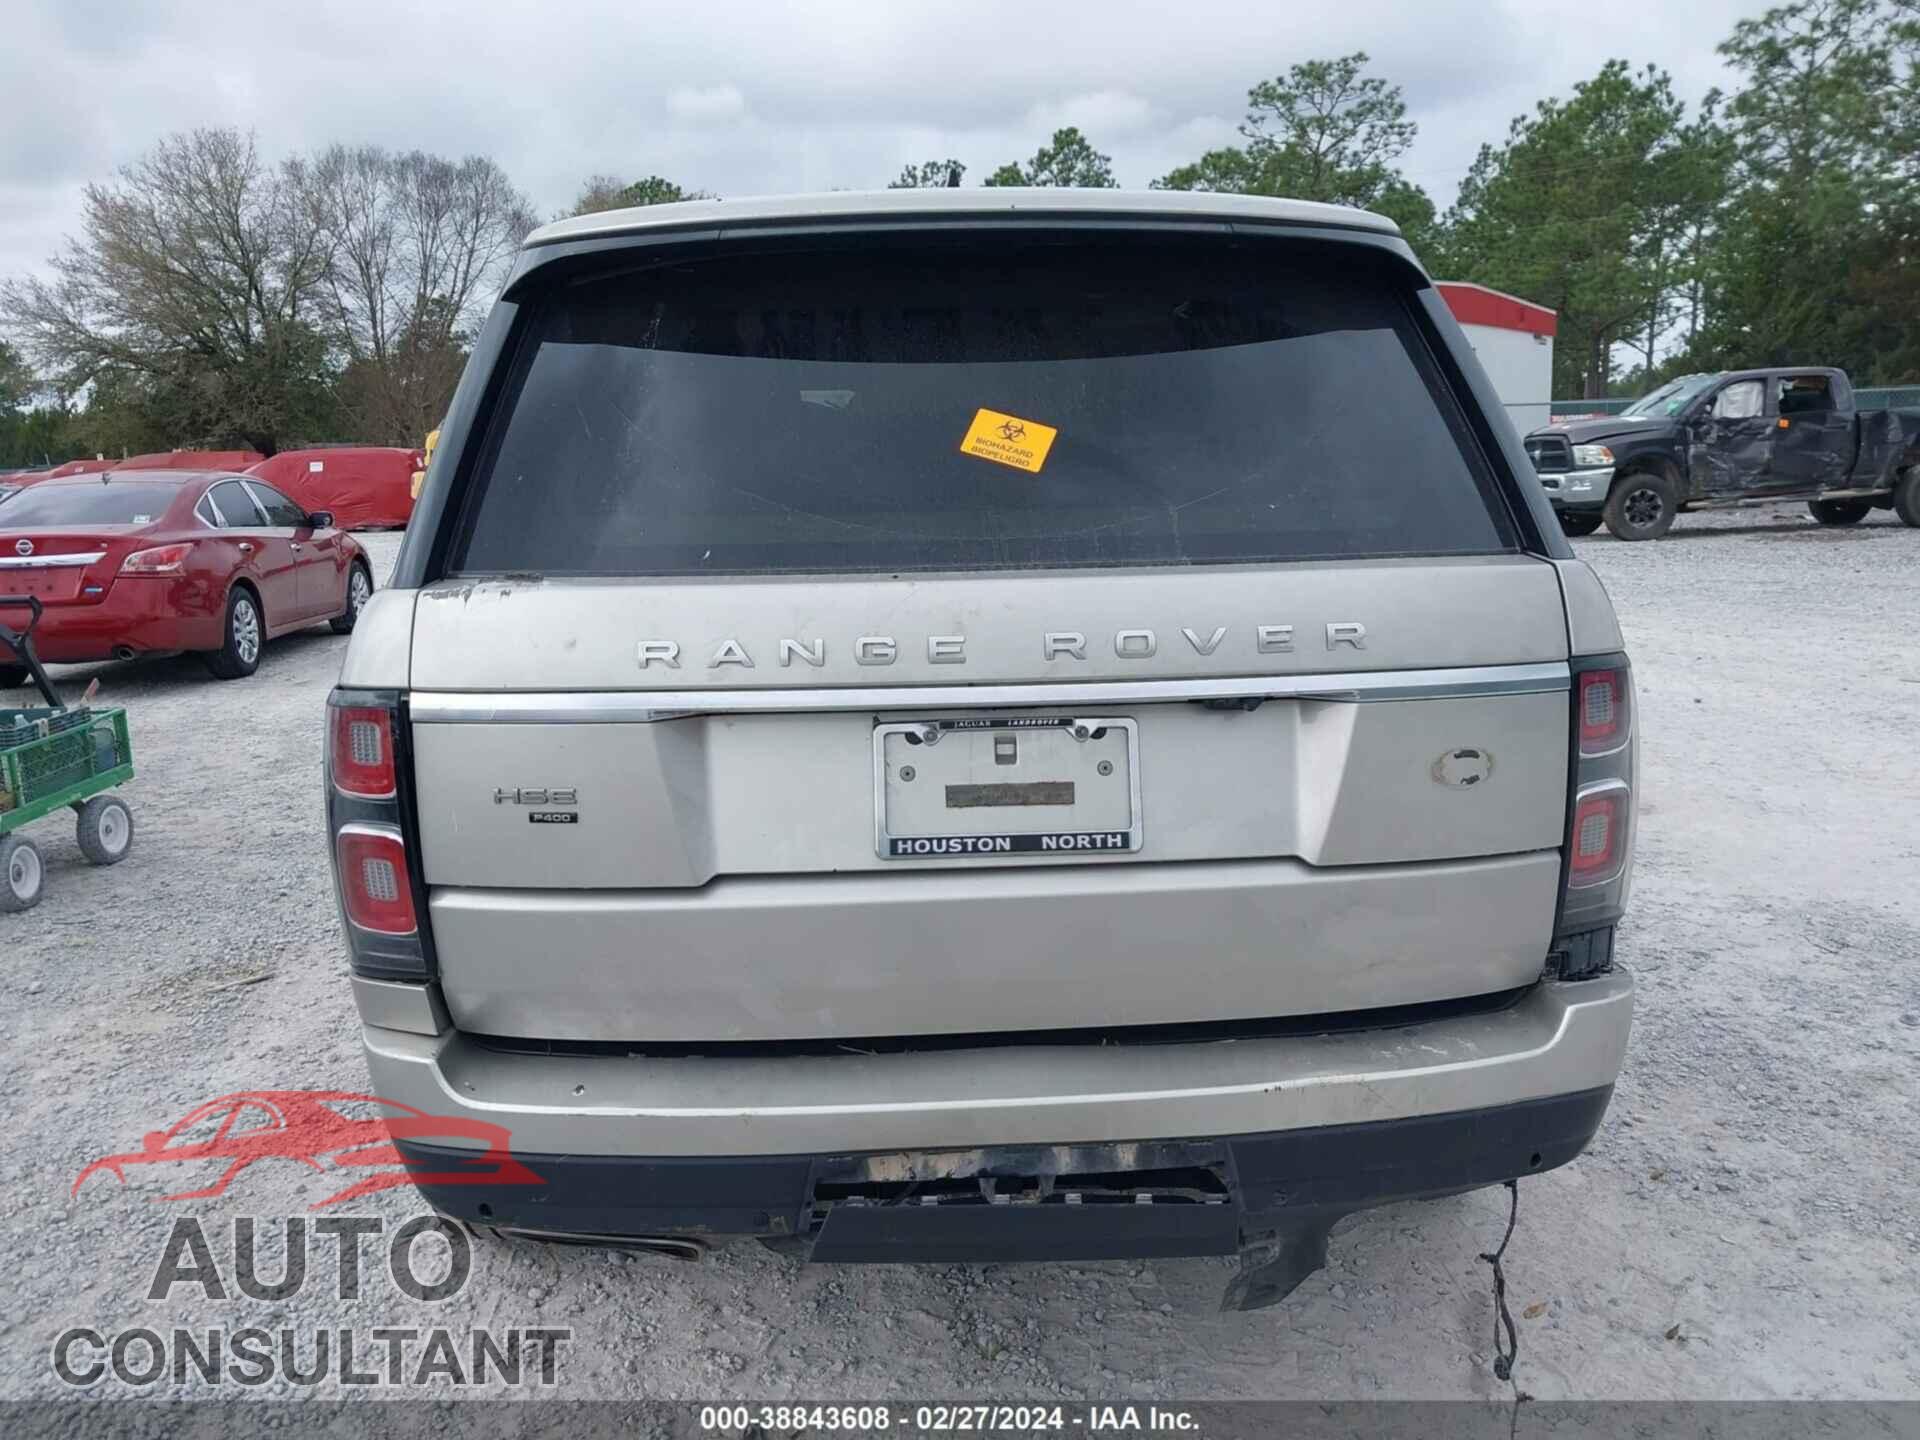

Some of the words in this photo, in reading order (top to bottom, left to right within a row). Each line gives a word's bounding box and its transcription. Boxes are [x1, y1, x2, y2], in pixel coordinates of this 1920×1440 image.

[976, 437, 1033, 458] BIOHAZARD
[637, 635, 967, 669] RANGE
[1044, 622, 1367, 660] ROVER
[954, 719, 991, 729] JAGUAR
[493, 787, 578, 805] HSE
[897, 837, 1011, 854] HOUSTON
[1041, 834, 1122, 850] NORTH
